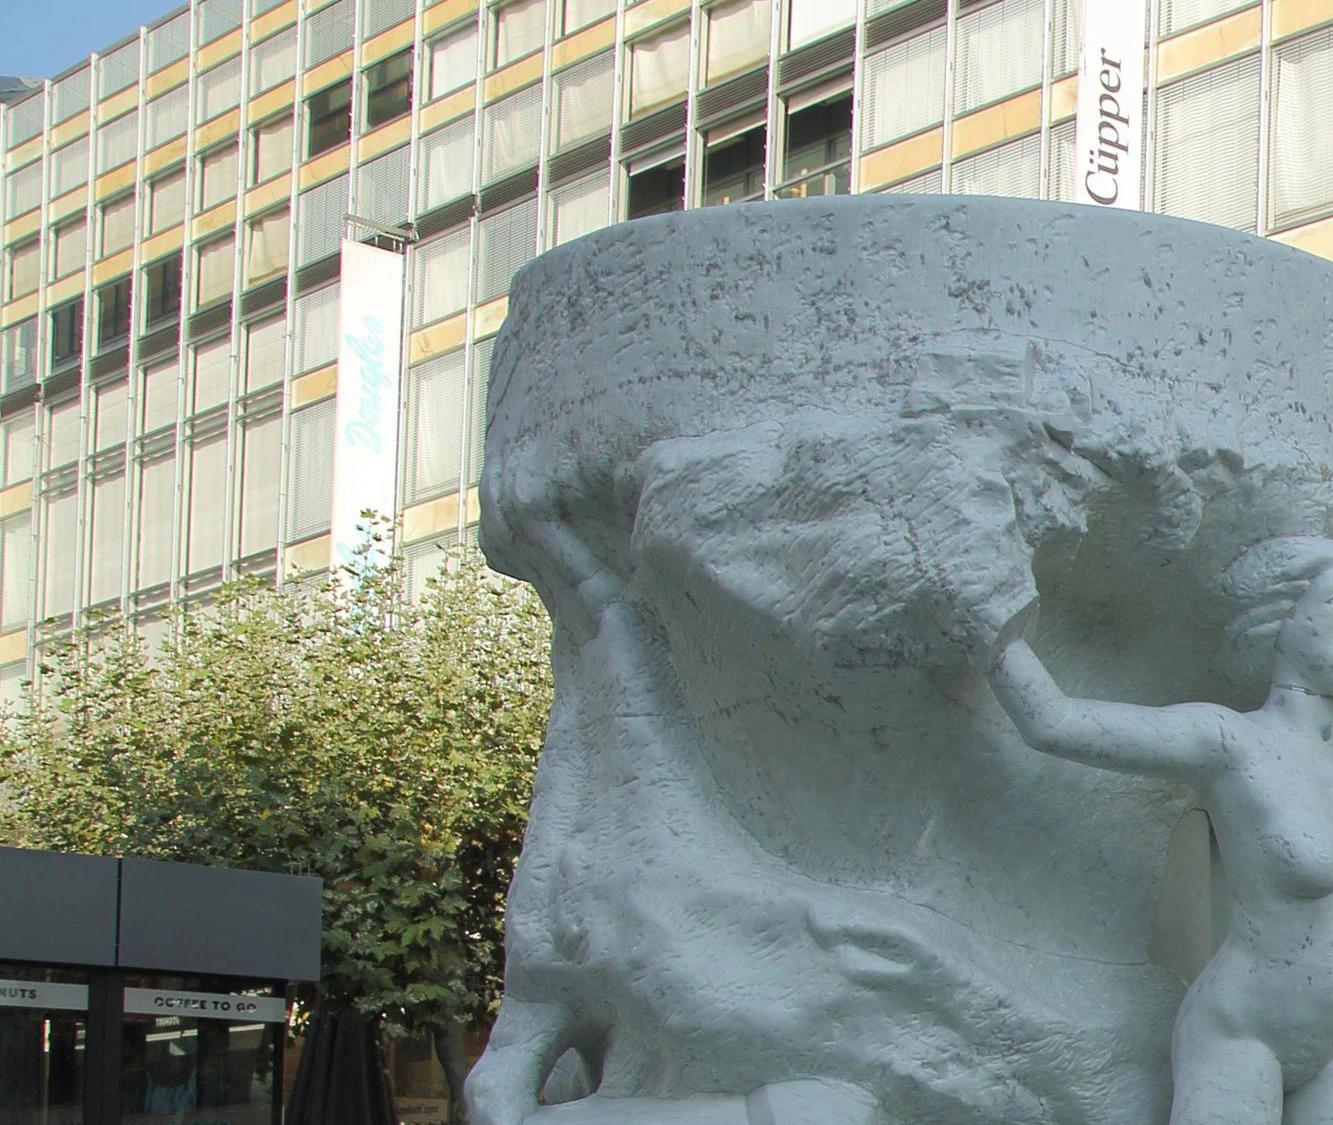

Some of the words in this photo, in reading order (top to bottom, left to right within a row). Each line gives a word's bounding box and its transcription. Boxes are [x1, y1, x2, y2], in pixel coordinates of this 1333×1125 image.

[154, 996, 207, 1010] COFFEE
[212, 1000, 231, 1011] TO
[236, 1002, 258, 1013] GO
